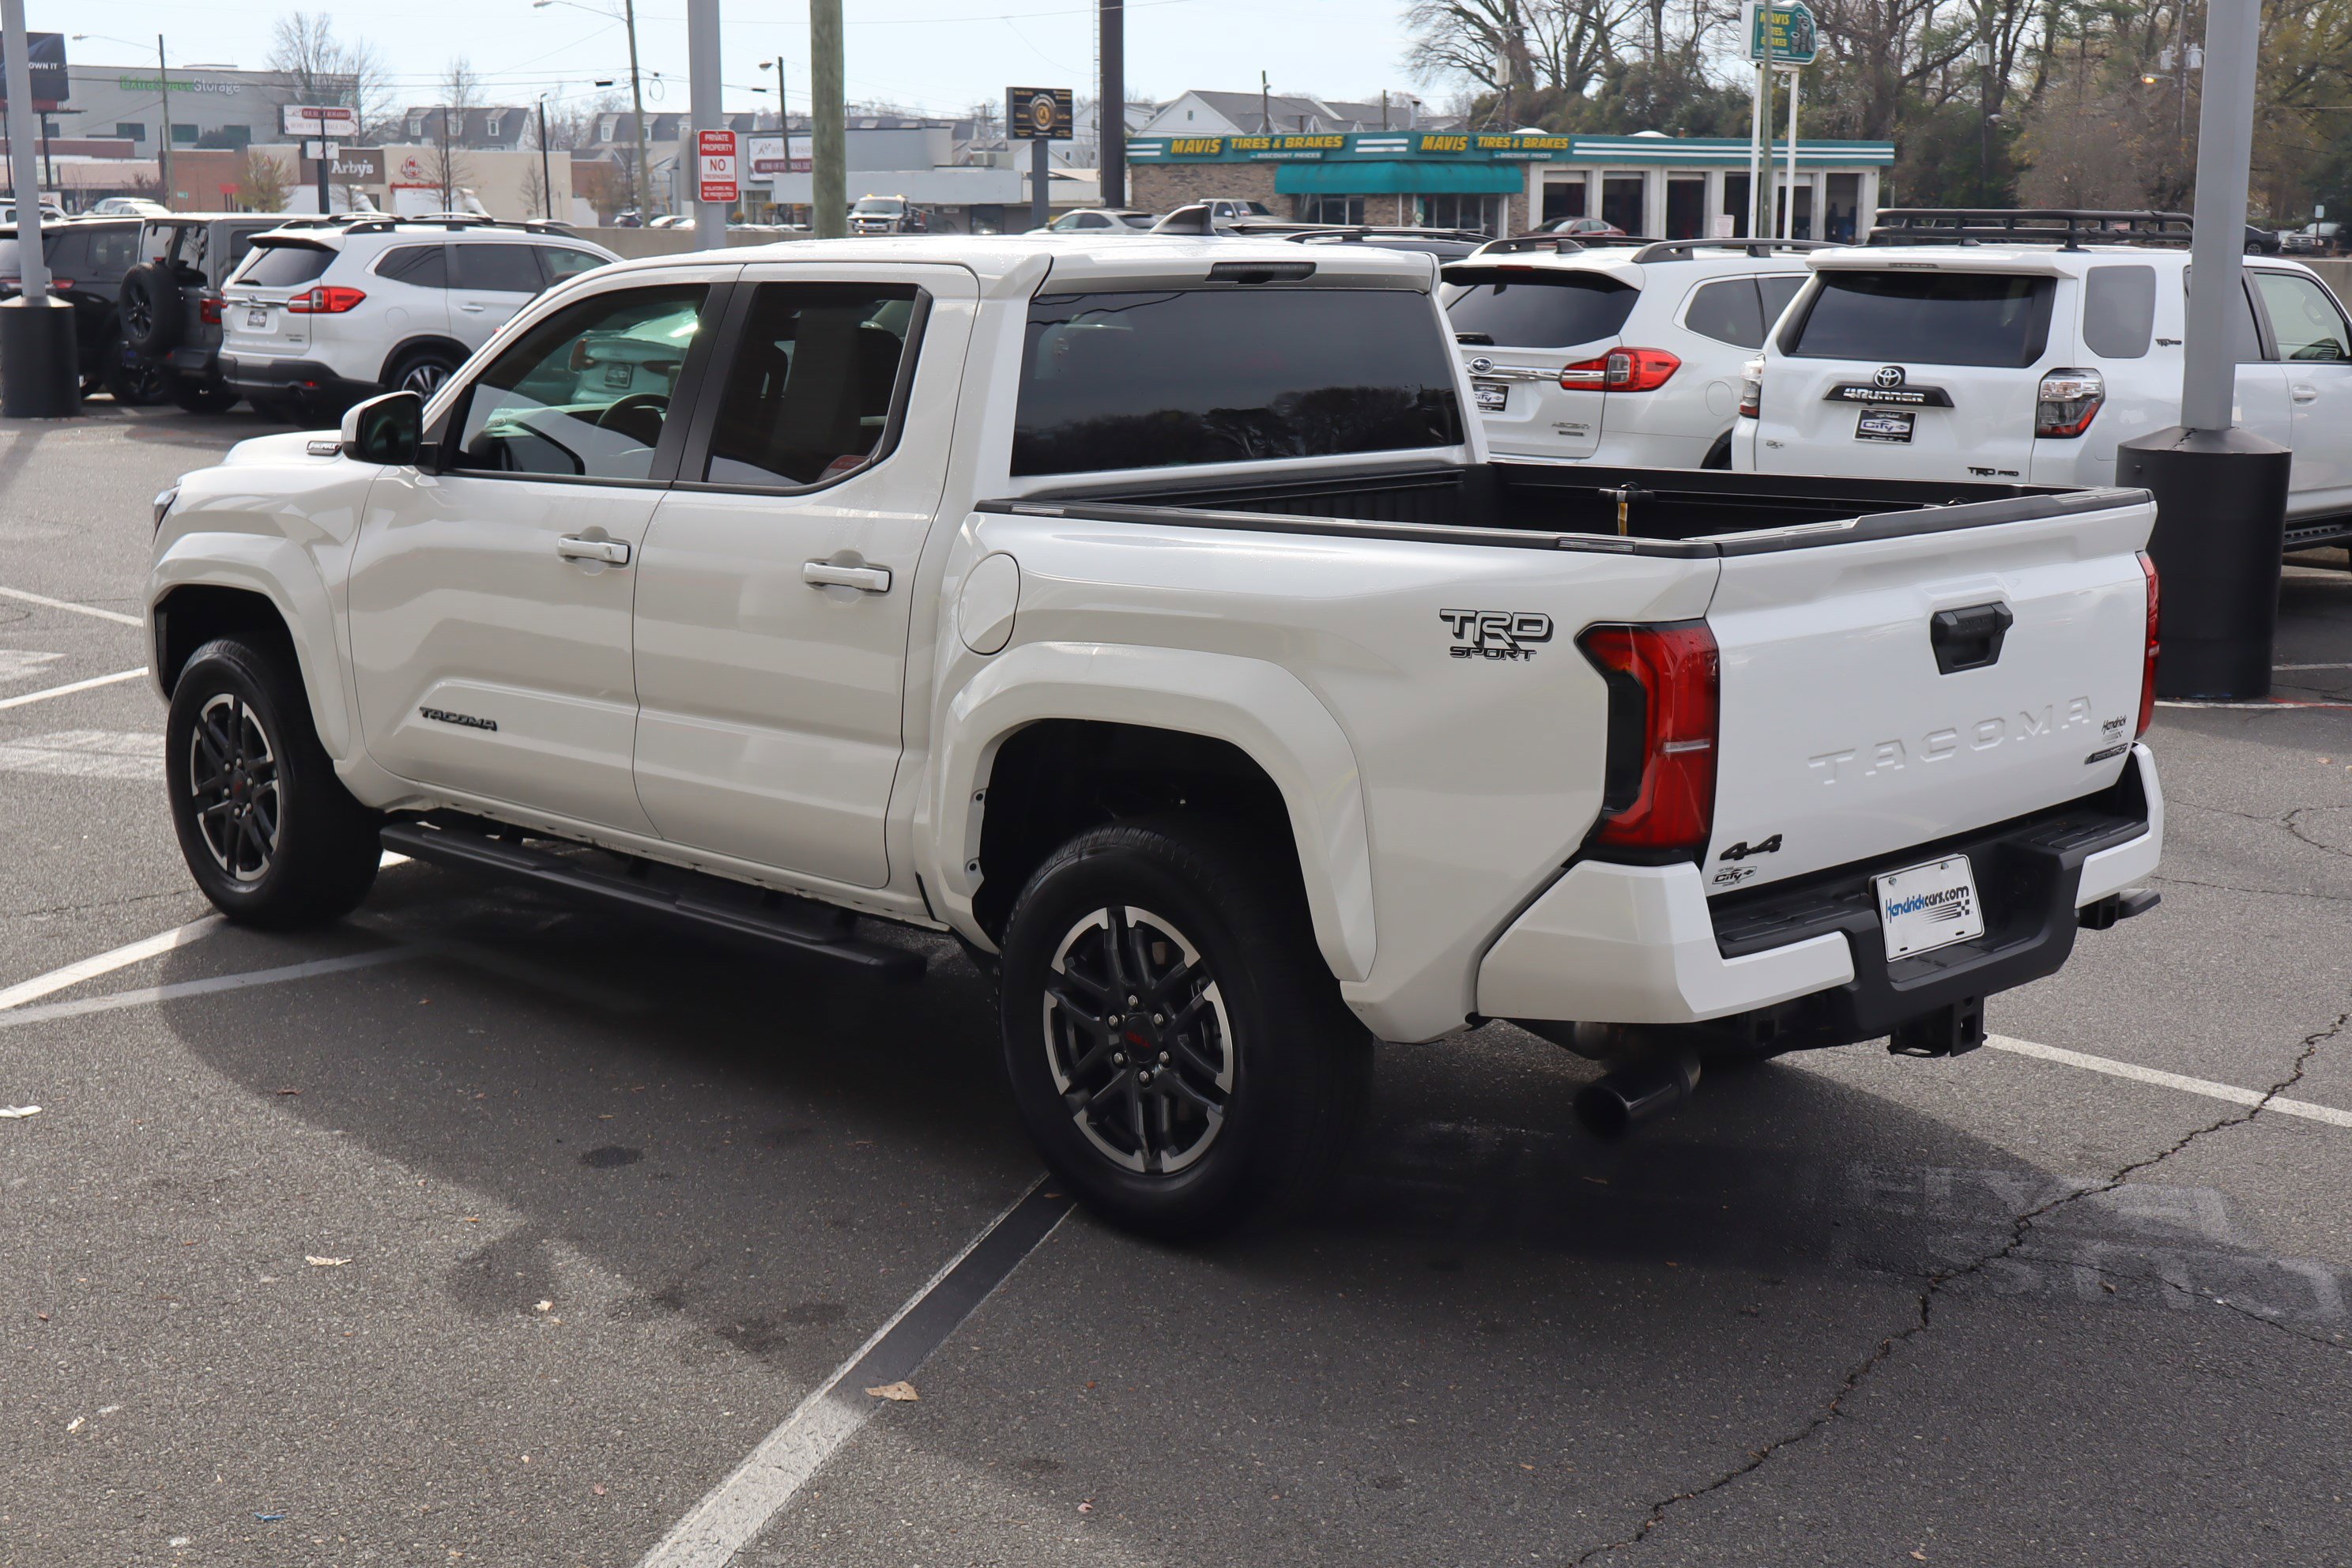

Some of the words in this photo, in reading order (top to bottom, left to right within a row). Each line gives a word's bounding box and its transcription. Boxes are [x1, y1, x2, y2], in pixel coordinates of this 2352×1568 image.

[1170, 138, 1223, 153] MAVIS
[1231, 137, 1272, 149] TIRES
[1272, 138, 1281, 149] &
[1284, 135, 1344, 149] BRAKES
[1420, 135, 1469, 152] MAVIS
[1477, 136, 1512, 149] TIRES
[1513, 138, 1520, 148] &
[1522, 137, 1570, 149] BRAKES
[331, 159, 374, 178] Arby's
[710, 158, 726, 172] NO
[1863, 420, 1894, 432] City
[1966, 466, 1996, 477] TRD
[1439, 609, 1555, 650] TRD
[1449, 646, 1537, 662] SPORT
[419, 707, 497, 731] TACOMA
[1807, 695, 2092, 785] TACOMA
[1715, 869, 1742, 883] City
[1885, 885, 1969, 924] Hendrickcars.com
